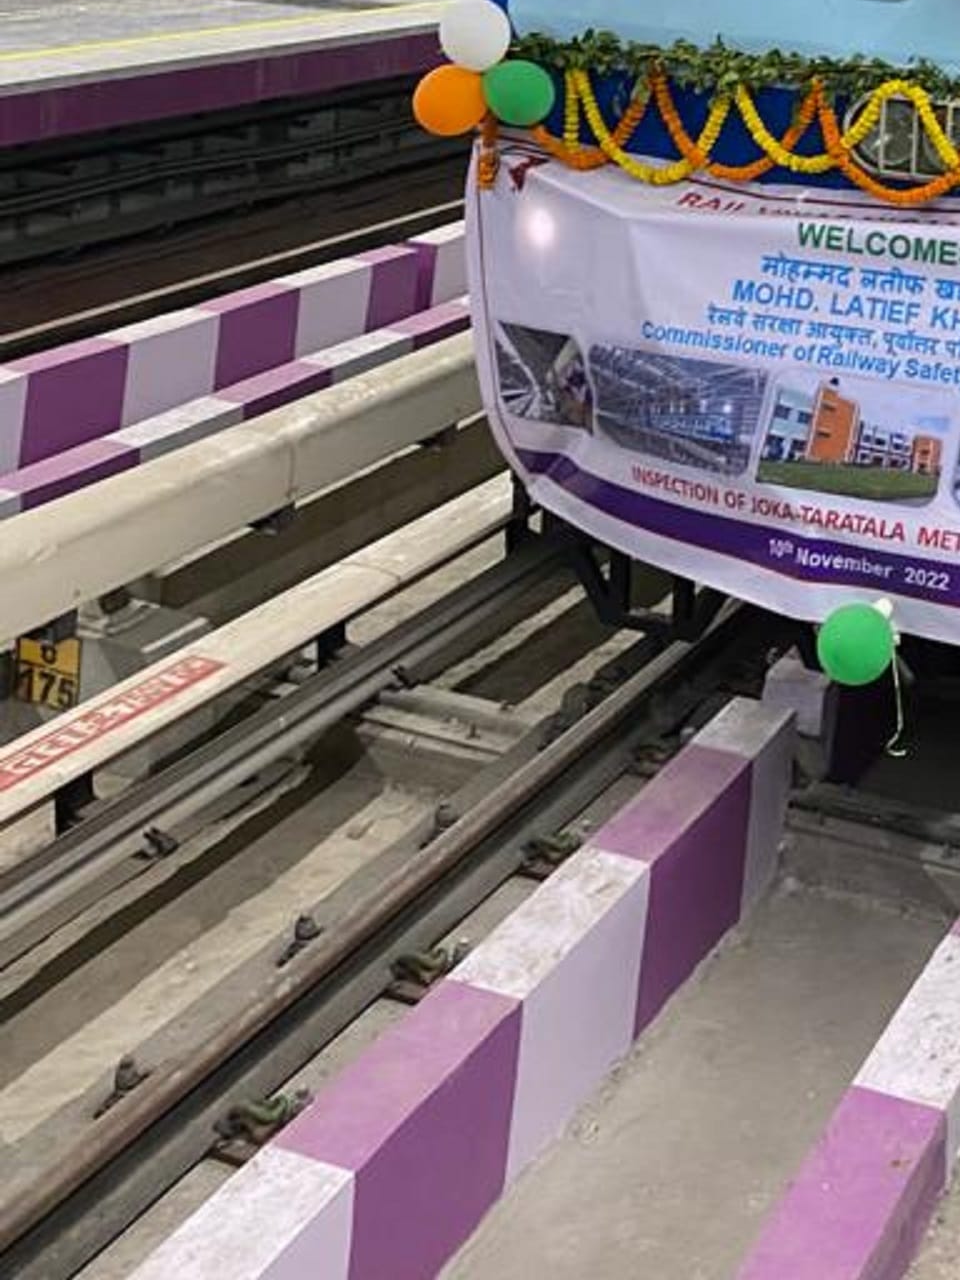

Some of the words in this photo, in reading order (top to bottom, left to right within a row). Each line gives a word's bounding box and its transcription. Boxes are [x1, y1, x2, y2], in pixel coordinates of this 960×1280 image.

[731, 279, 820, 312] MOHD.
[829, 293, 921, 326] LATIEF
[641, 321, 789, 357] Commissioner
[792, 343, 818, 363] of
[816, 345, 902, 379] Railway
[632, 464, 720, 505] INSPECTION
[724, 489, 747, 509] OF
[751, 496, 905, 542] JOKA-TARATALA
[796, 546, 893, 578] November
[903, 567, 951, 591] 2022
